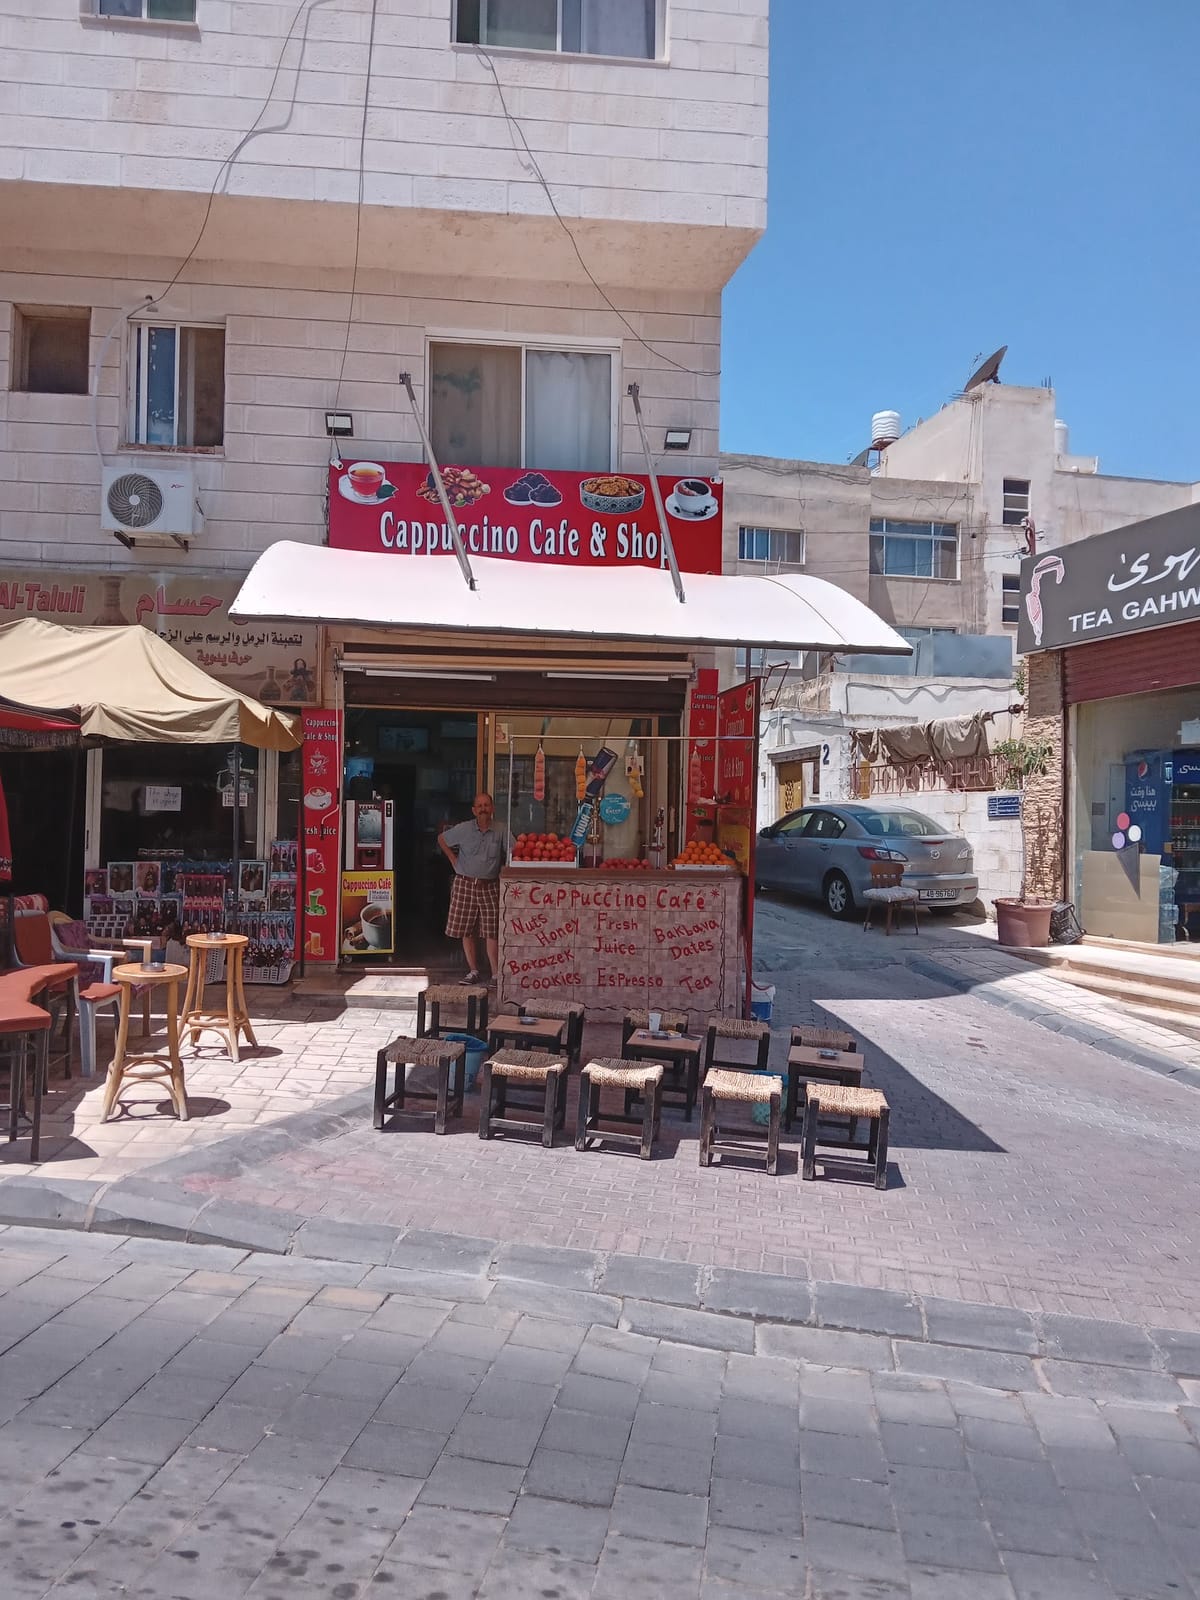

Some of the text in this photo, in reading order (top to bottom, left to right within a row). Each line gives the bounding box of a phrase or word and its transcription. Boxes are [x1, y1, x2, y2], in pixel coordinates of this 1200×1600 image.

[379, 510, 518, 554] Cappuccino
[528, 519, 580, 556] Cafe
[590, 521, 607, 558] &
[136, 584, 224, 623] حسام
[1068, 588, 1200, 632] TEA GAHW
[154, 628, 182, 643] الزجا
[205, 631, 240, 647] والرسم
[242, 632, 269, 647] الرمل
[305, 718, 338, 728] Cappuccin
[823, 744, 829, 765] 2
[342, 878, 377, 892] Cappuccino
[656, 888, 705, 910] Café
[511, 913, 548, 936] Nuts
[596, 912, 638, 930] Fresh
[535, 917, 580, 946] Honey
[593, 936, 637, 955] Juice
[670, 939, 715, 960] Dates
[679, 975, 713, 994] Tea
